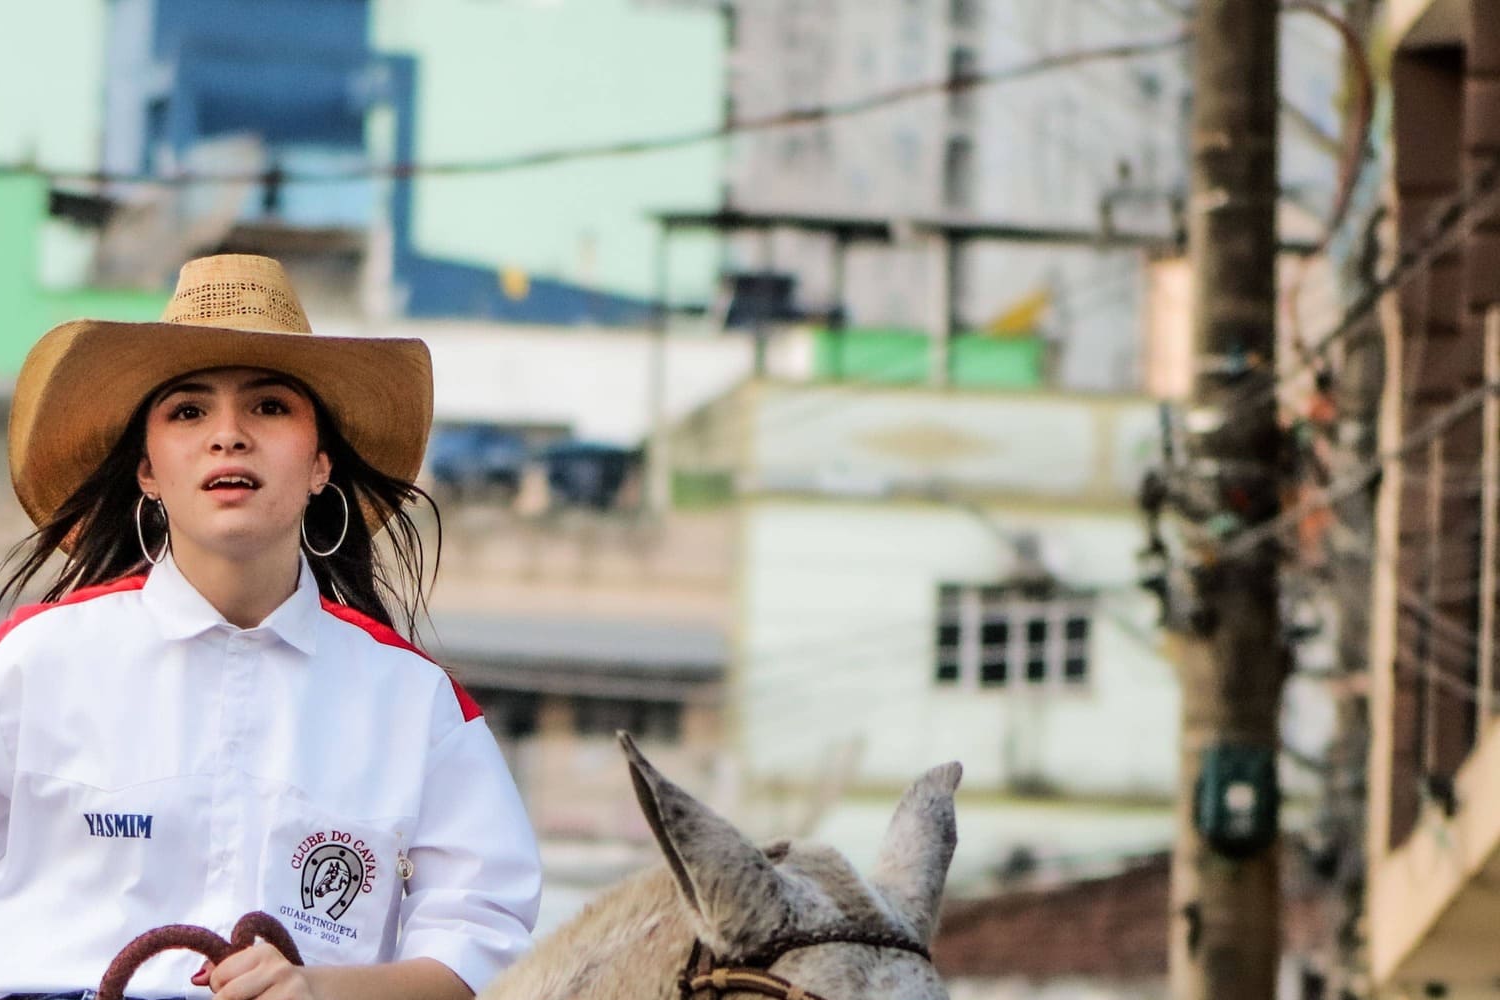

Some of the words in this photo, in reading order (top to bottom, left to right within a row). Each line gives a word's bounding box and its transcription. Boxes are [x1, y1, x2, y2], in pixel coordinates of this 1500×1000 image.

[83, 813, 153, 839] YASMIM
[291, 832, 326, 869] CLUBE
[331, 830, 351, 844] DO
[353, 840, 376, 893] CAVALO
[280, 905, 357, 939] GUARATINGUETÁ
